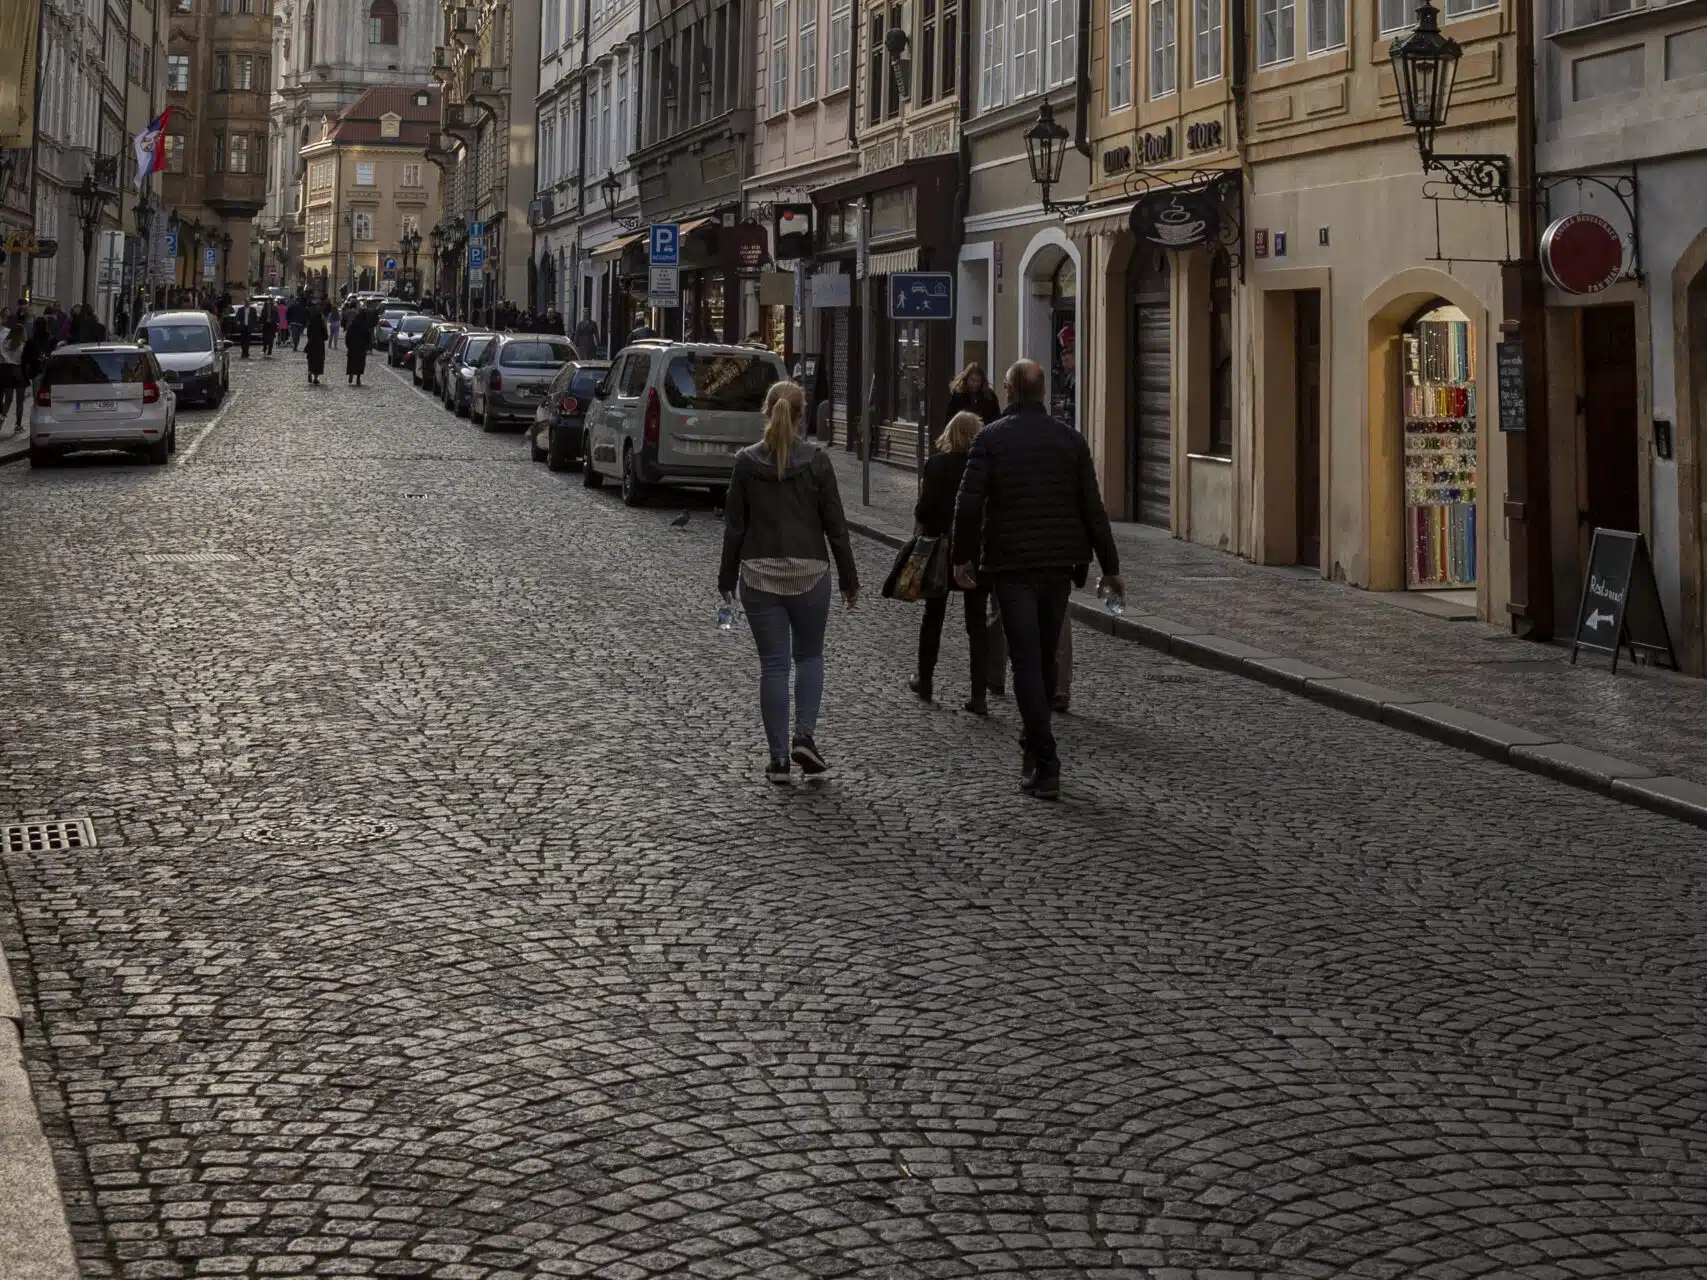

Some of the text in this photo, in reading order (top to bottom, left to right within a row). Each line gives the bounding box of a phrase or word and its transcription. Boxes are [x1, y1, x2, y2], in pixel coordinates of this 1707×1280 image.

[1144, 125, 1172, 163] food
[1187, 119, 1221, 150] store
[656, 228, 672, 252] P
[206, 250, 215, 262] P
[472, 248, 481, 261] P
